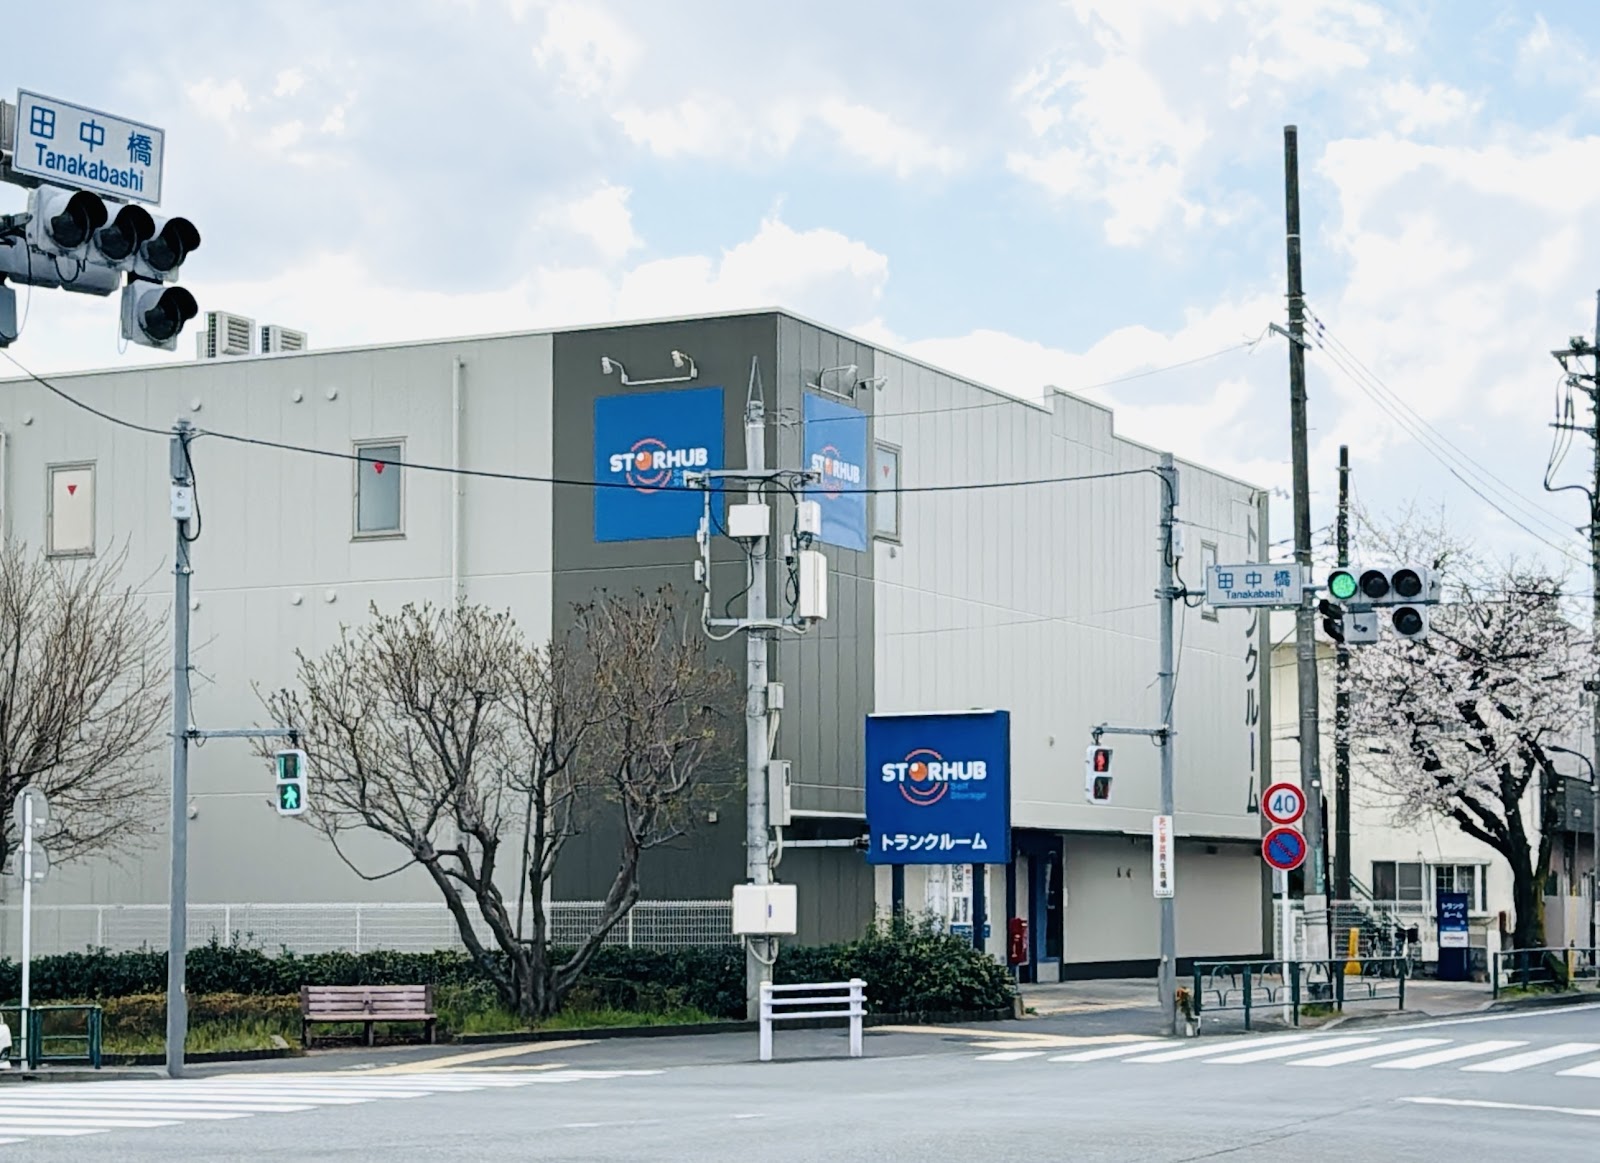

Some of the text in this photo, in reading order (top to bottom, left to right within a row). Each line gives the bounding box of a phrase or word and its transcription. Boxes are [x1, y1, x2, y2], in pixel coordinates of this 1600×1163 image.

[30, 105, 153, 168] 田中橋
[35, 142, 144, 192] Tanakabashi
[609, 447, 708, 472] STORHUB
[811, 453, 860, 484] STORHUB
[1217, 569, 1291, 589] 田中橋
[1225, 588, 1284, 599] Tanakabashi
[1246, 513, 1260, 814] トンクルーム
[881, 761, 987, 782] STORHUB
[1273, 794, 1296, 814] 40
[881, 832, 988, 852] トランクルーム
